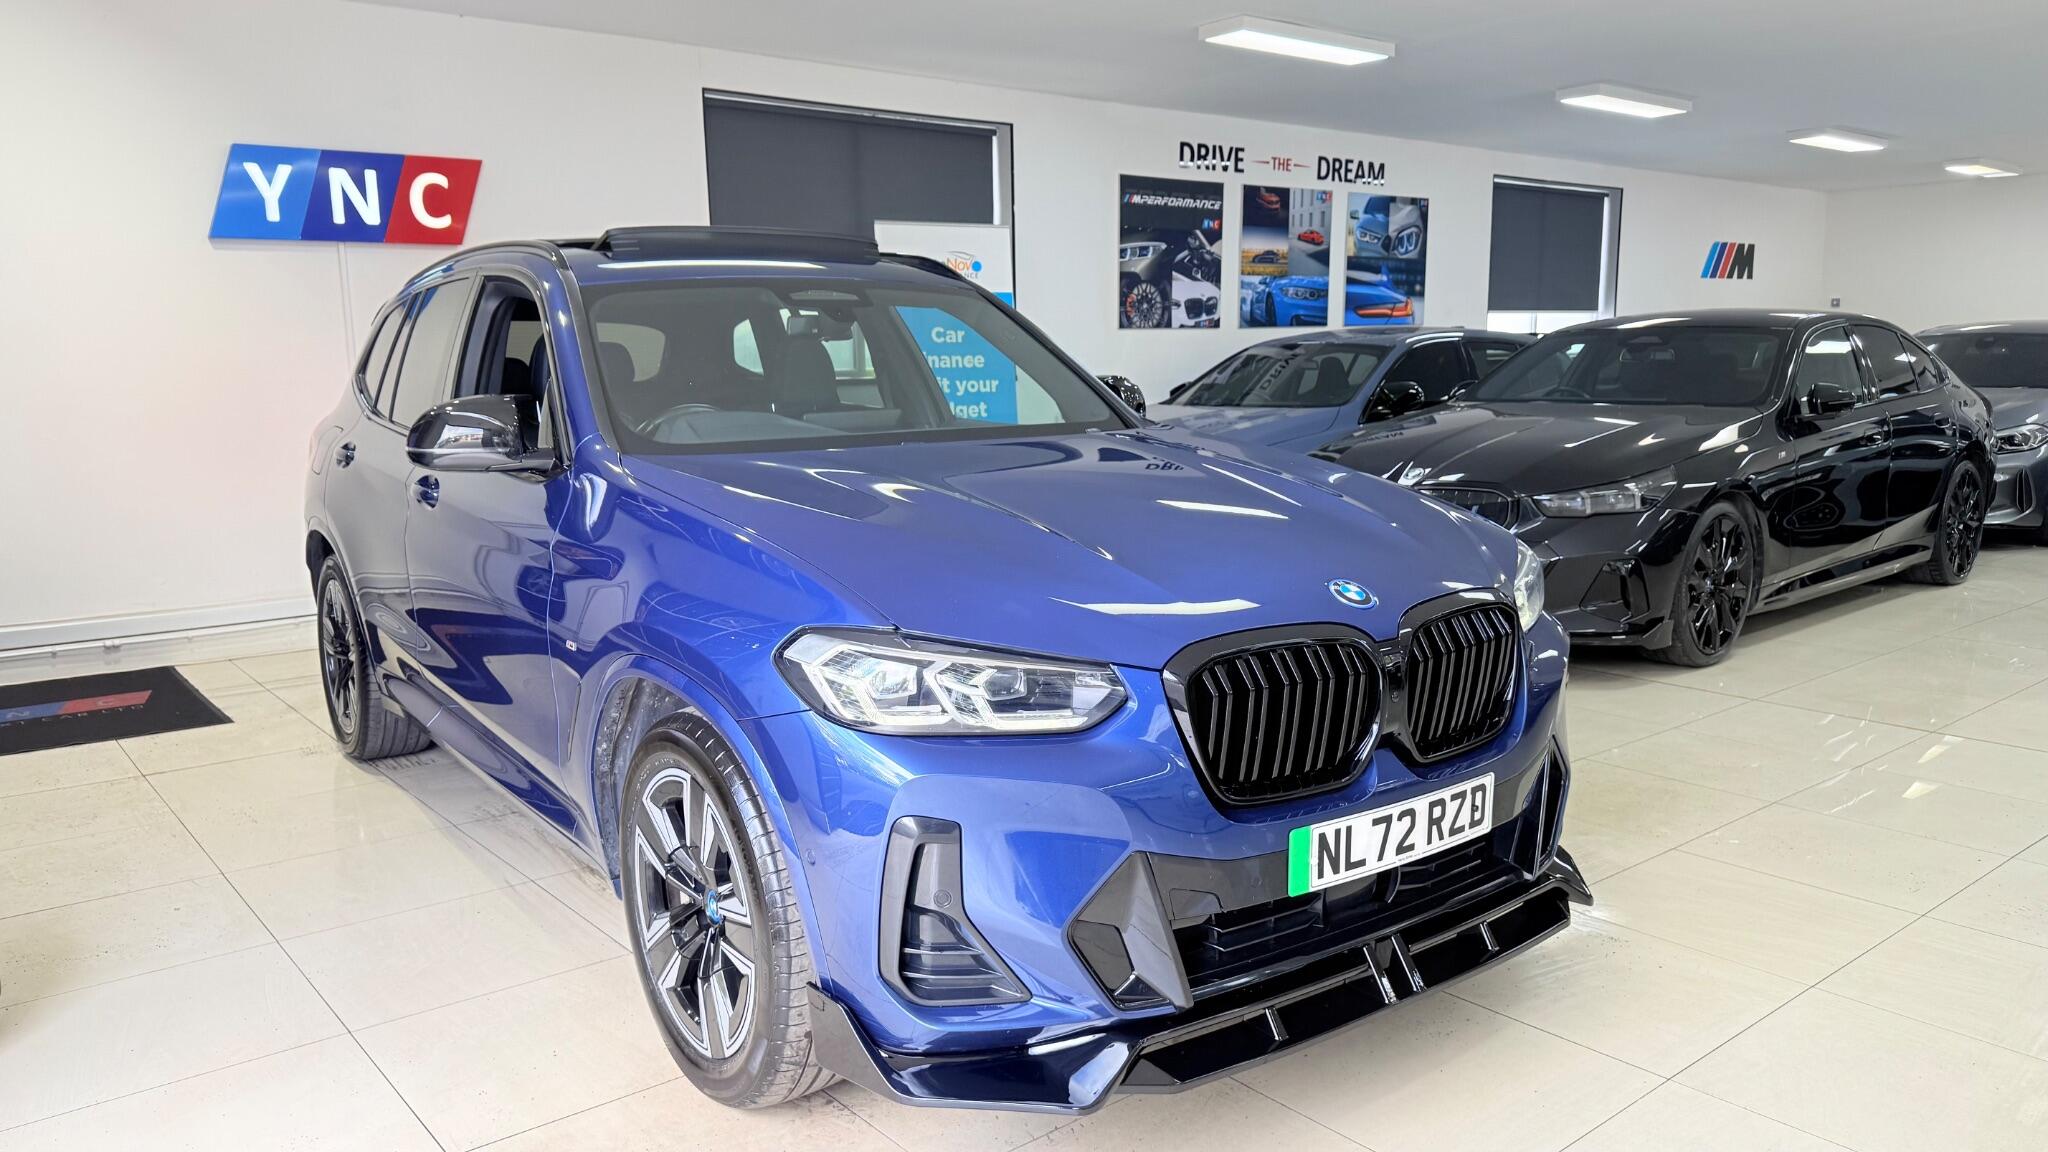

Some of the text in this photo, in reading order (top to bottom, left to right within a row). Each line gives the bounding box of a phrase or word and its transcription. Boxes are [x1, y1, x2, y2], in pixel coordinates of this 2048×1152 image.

[1179, 141, 1386, 186] DRIVE THE DREAM
[242, 161, 452, 229] YNC
[931, 326, 965, 343] Car
[924, 352, 985, 368] nance
[955, 379, 999, 396] your
[1426, 783, 1487, 846] RZD
